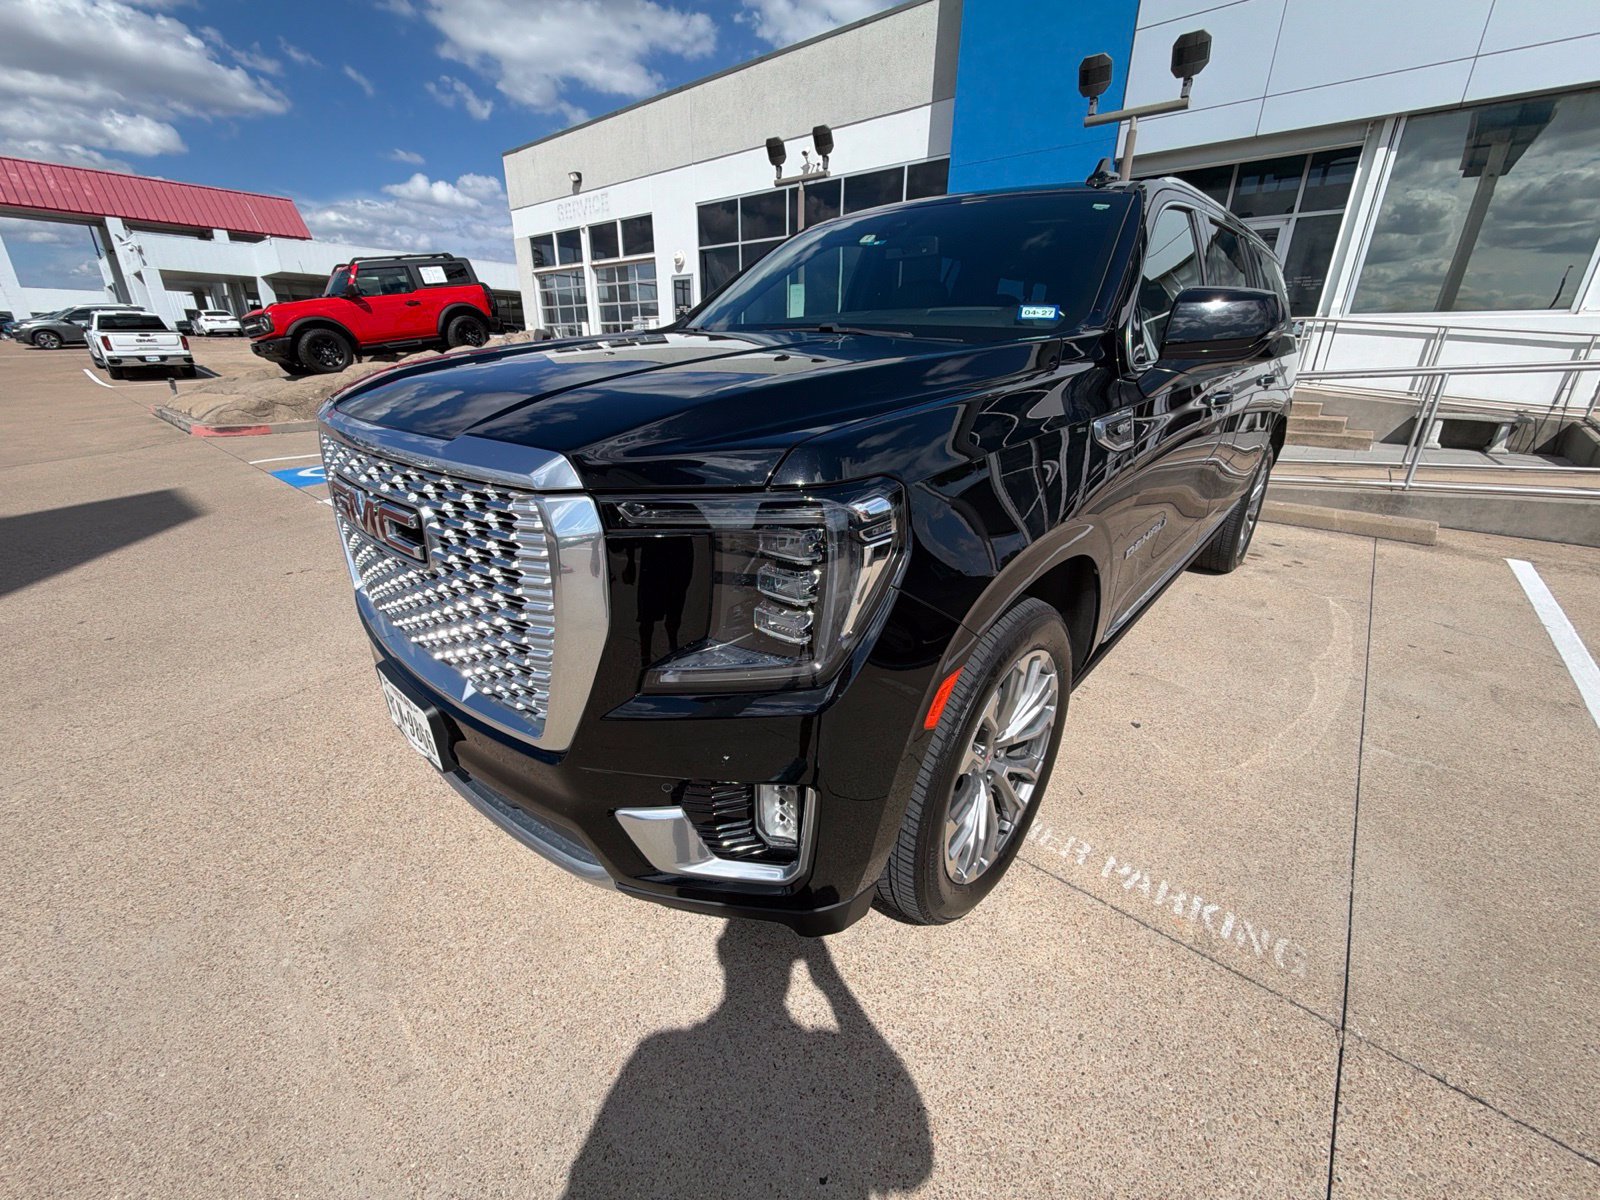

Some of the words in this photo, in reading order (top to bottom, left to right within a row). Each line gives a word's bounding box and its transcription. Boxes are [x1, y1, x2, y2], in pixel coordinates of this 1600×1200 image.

[556, 192, 609, 222] SERVICE
[329, 479, 426, 560] GMC
[1101, 855, 1307, 978] PARKING
